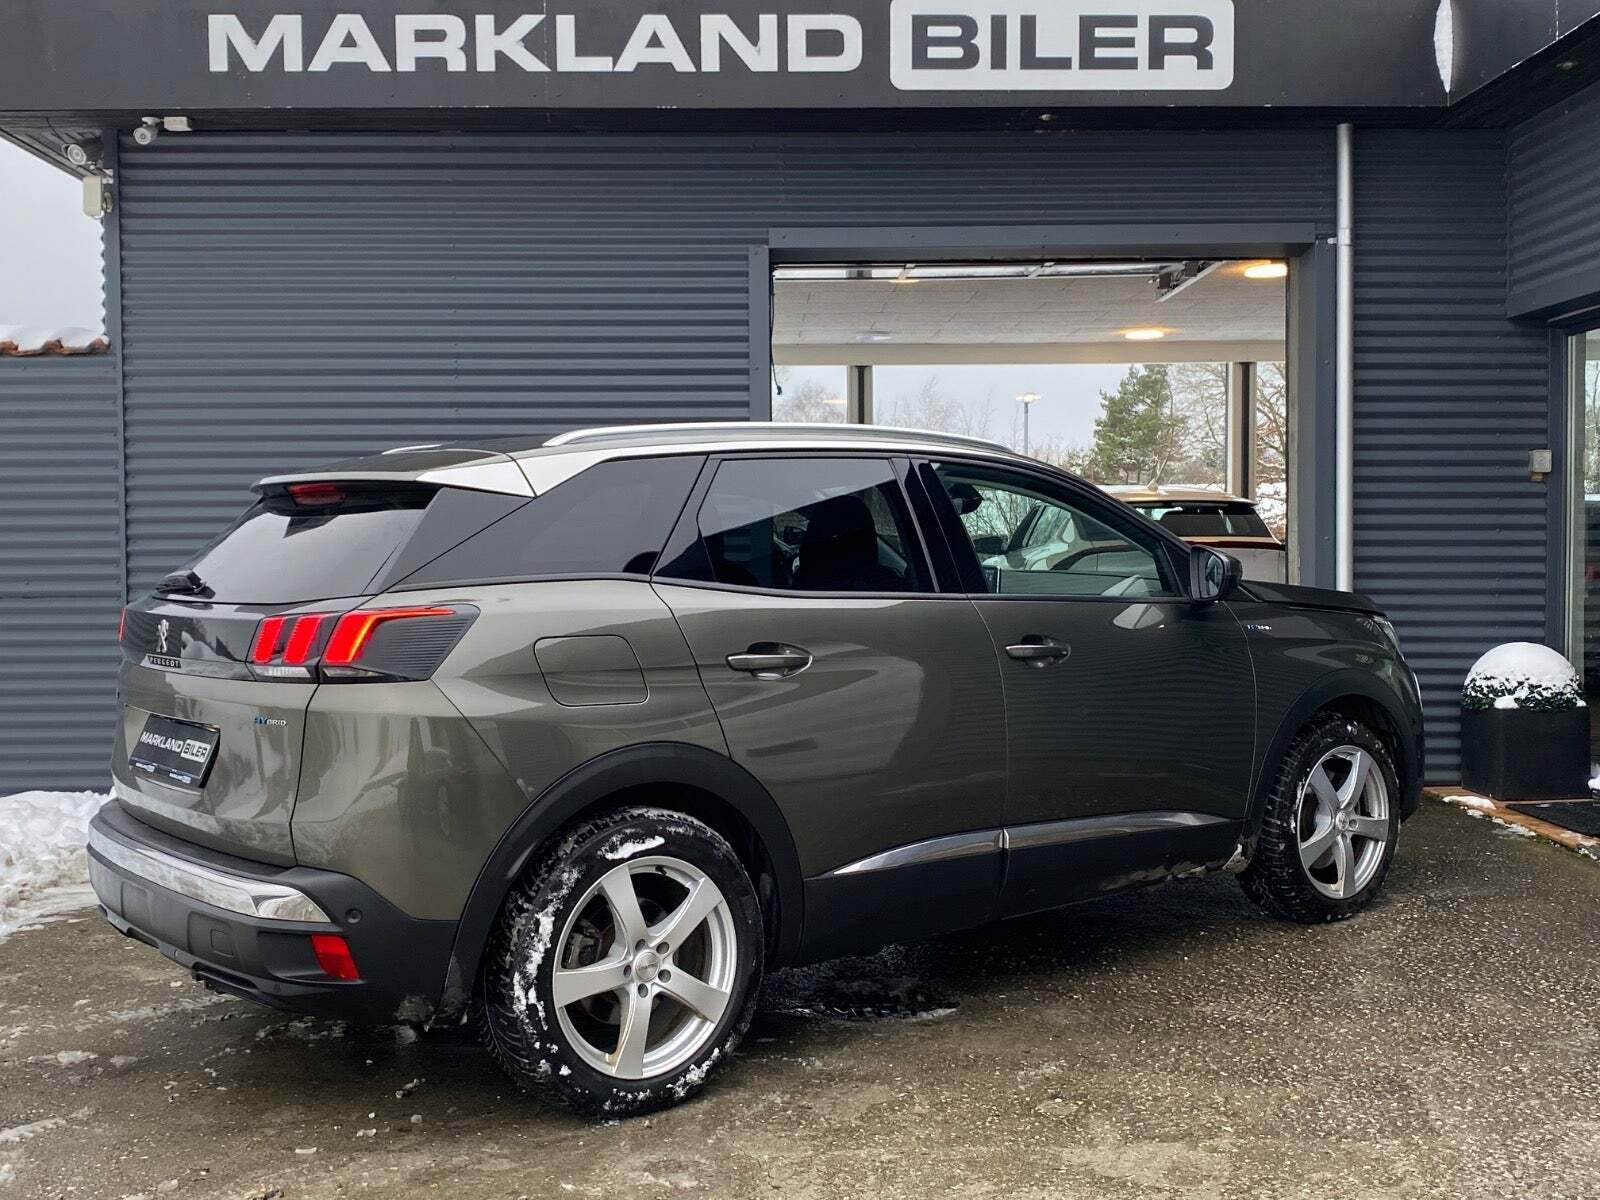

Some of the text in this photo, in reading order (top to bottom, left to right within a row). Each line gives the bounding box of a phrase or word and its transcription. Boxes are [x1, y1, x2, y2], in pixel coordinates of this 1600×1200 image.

[208, 14, 1214, 72] MARKLAND BILER
[140, 731, 208, 759] MARKLAND BILER
